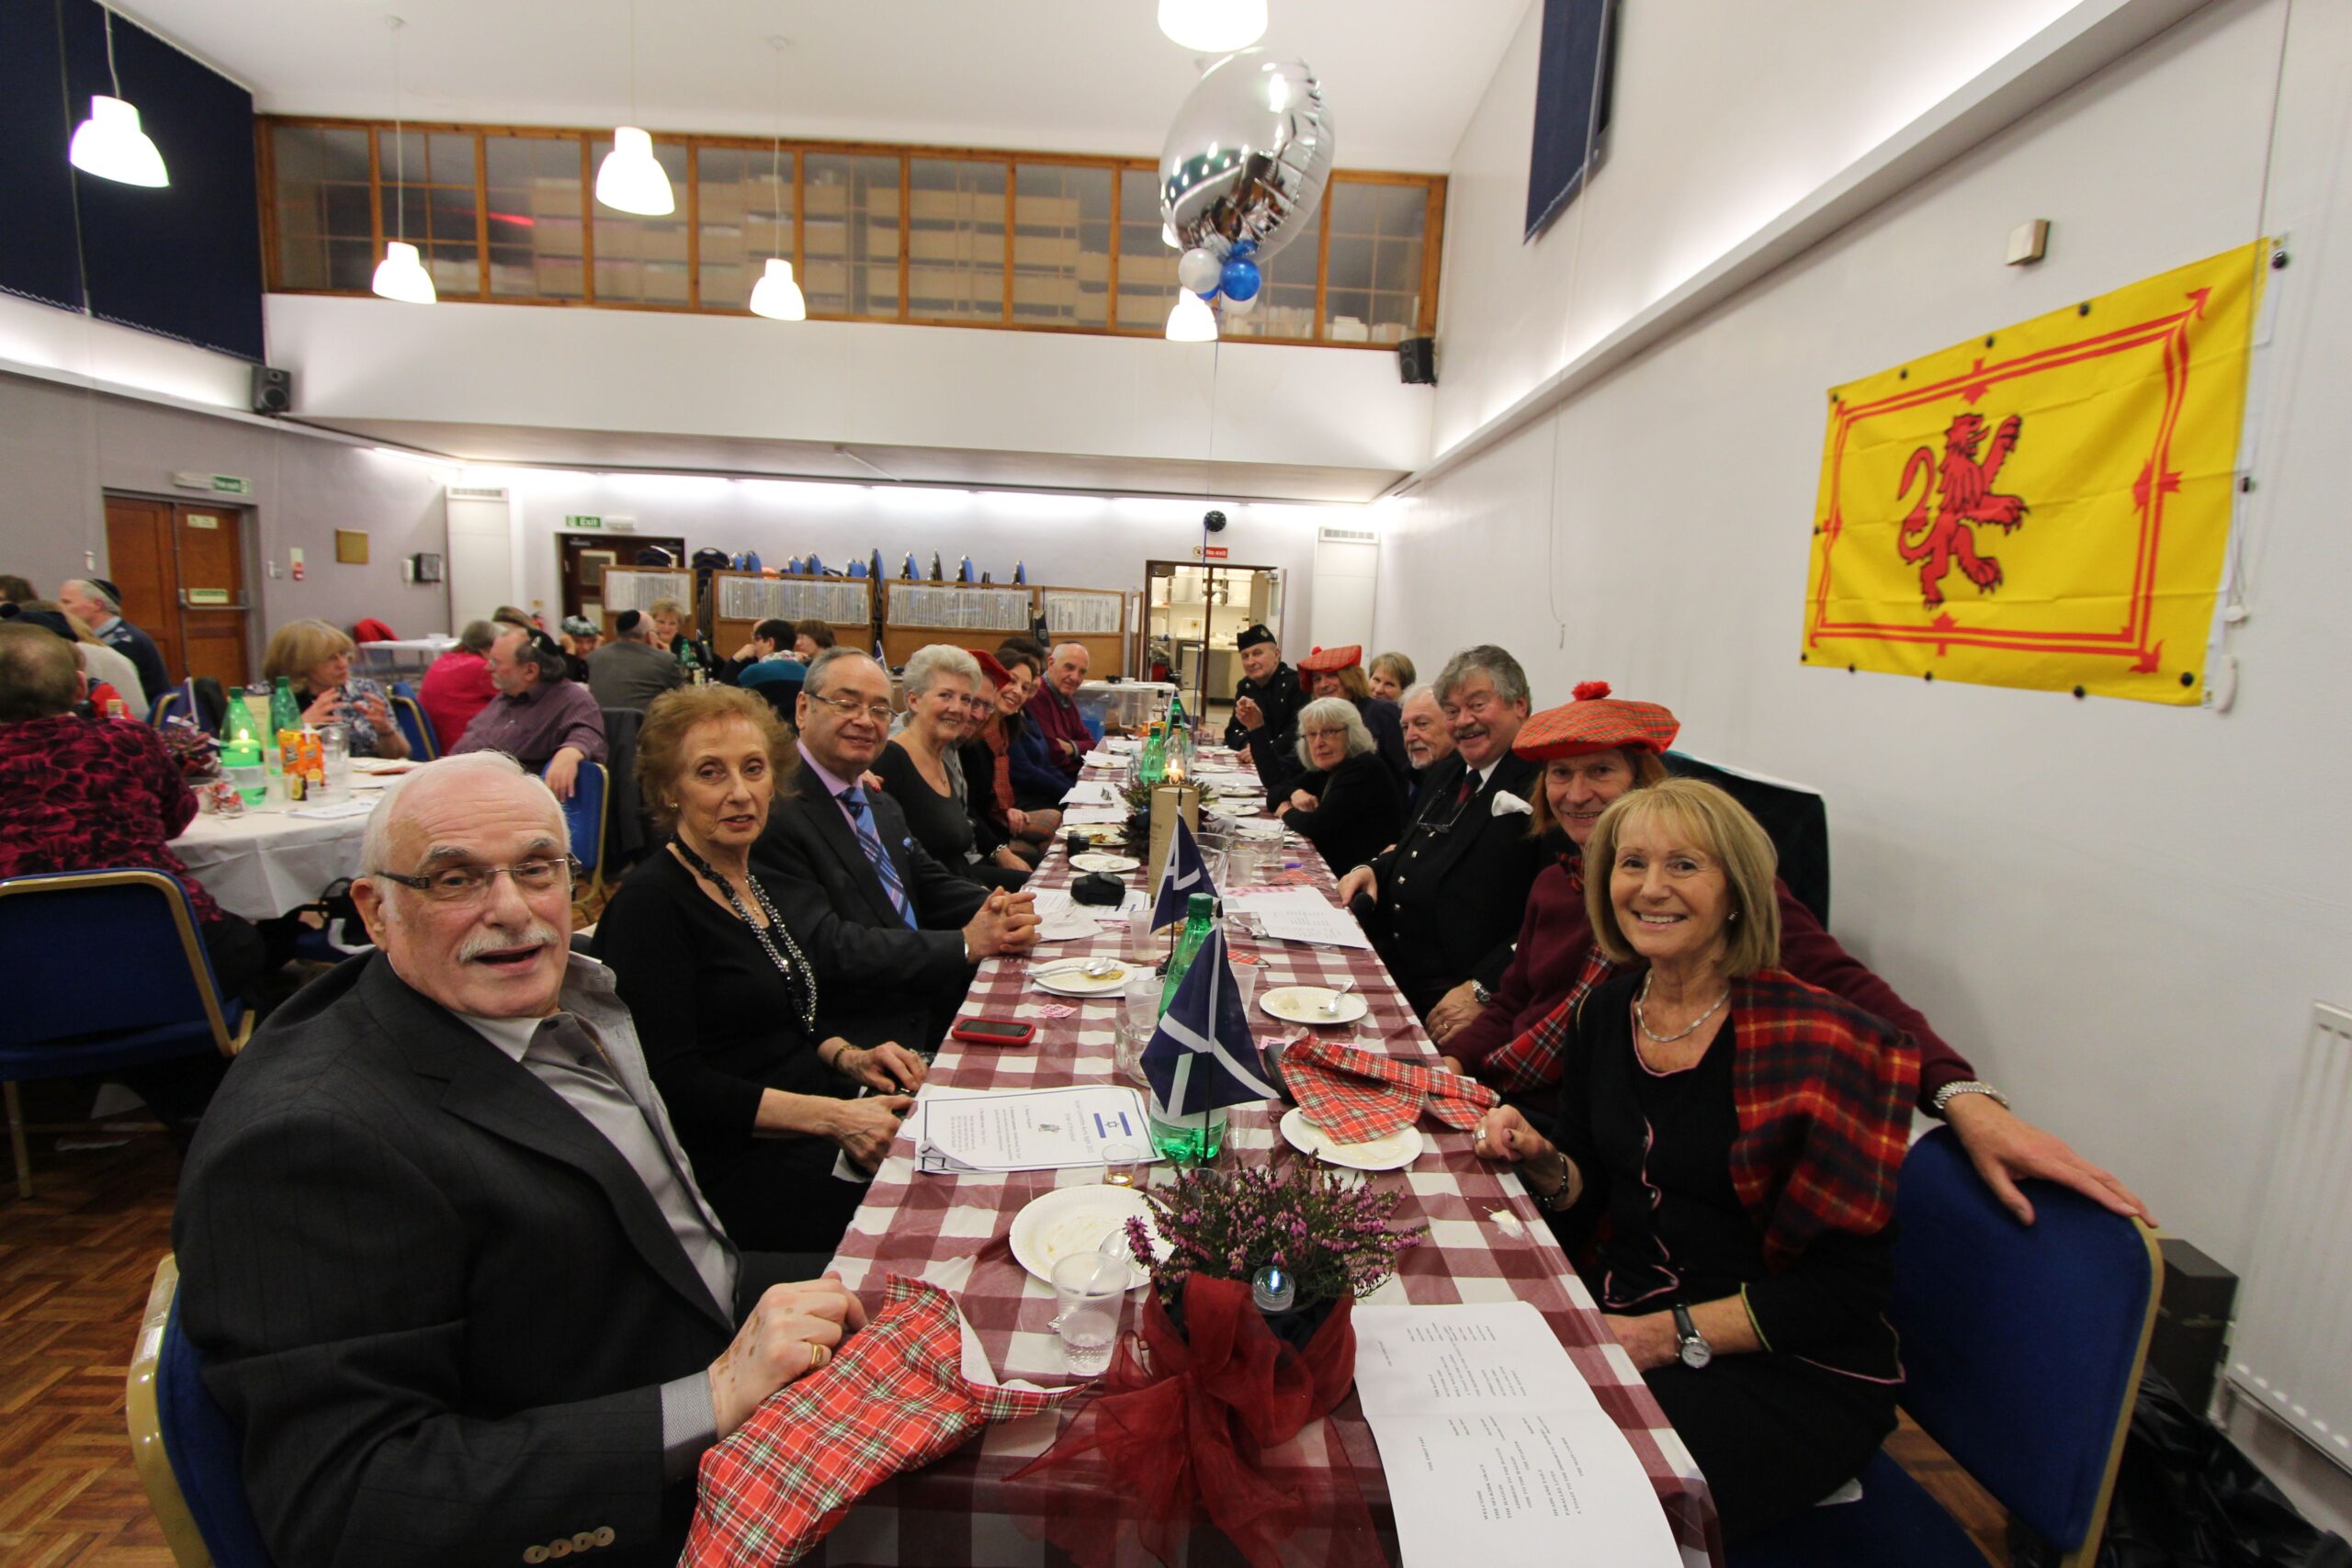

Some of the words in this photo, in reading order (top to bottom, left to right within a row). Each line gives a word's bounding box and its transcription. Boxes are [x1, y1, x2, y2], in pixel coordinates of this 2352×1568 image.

[580, 516, 597, 527] Exit
[1476, 1490, 1488, 1519] WELCOME
[1493, 1508, 1501, 1518] THE
